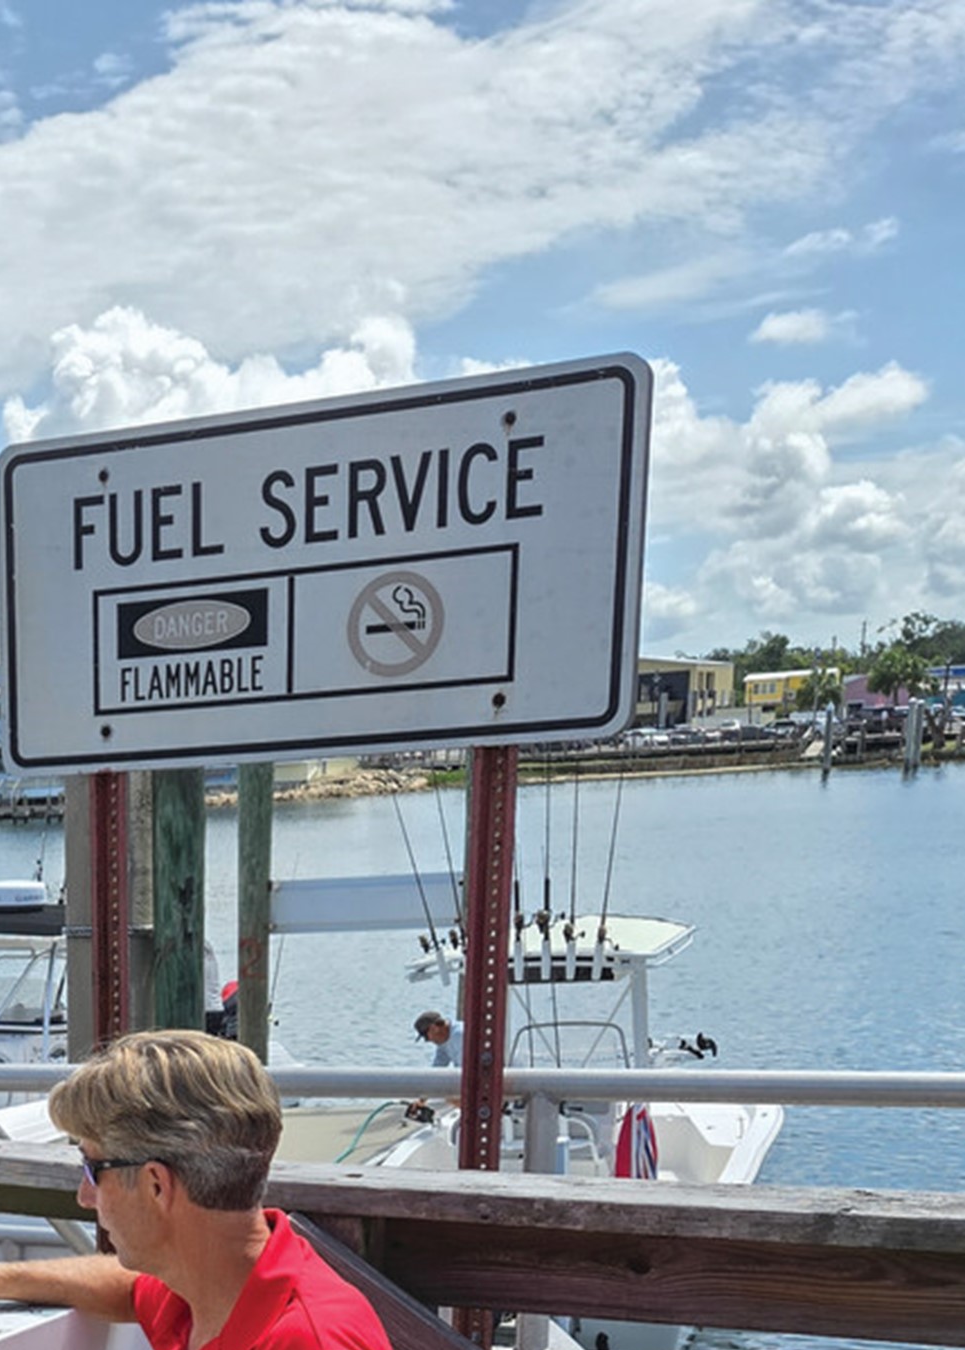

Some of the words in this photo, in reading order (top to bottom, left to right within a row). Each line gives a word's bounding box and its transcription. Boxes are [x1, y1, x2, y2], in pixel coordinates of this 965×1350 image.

[73, 482, 225, 571] FUEL
[259, 435, 545, 549] SERVICE
[153, 611, 229, 642] DANGER
[120, 655, 265, 702] FLAMMABLE
